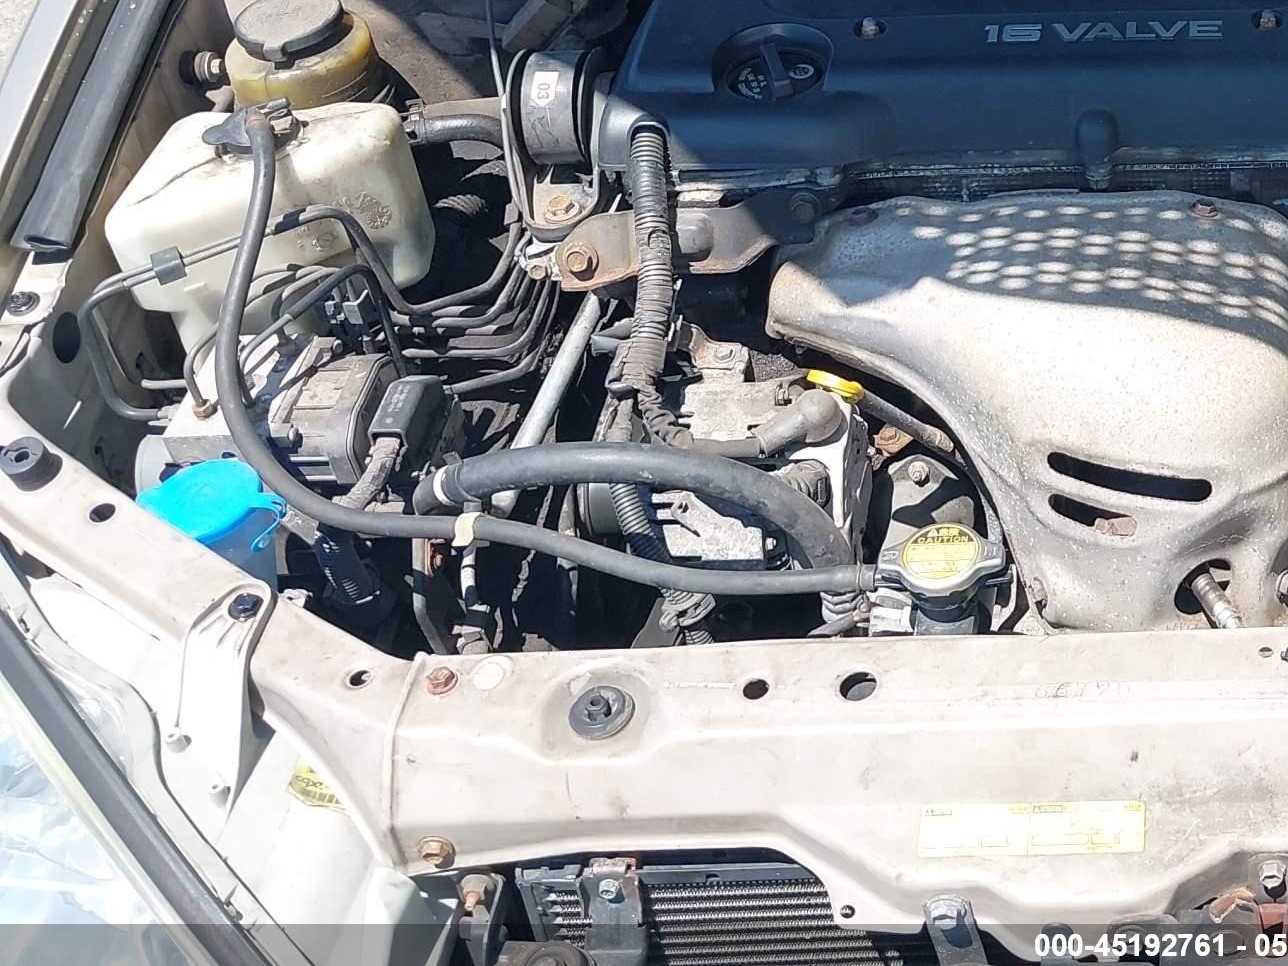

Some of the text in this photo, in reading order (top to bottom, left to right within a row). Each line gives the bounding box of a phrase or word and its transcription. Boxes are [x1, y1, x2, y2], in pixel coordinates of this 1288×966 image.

[984, 20, 1223, 43] 16 VALVE
[917, 535, 969, 544] CAUTION
